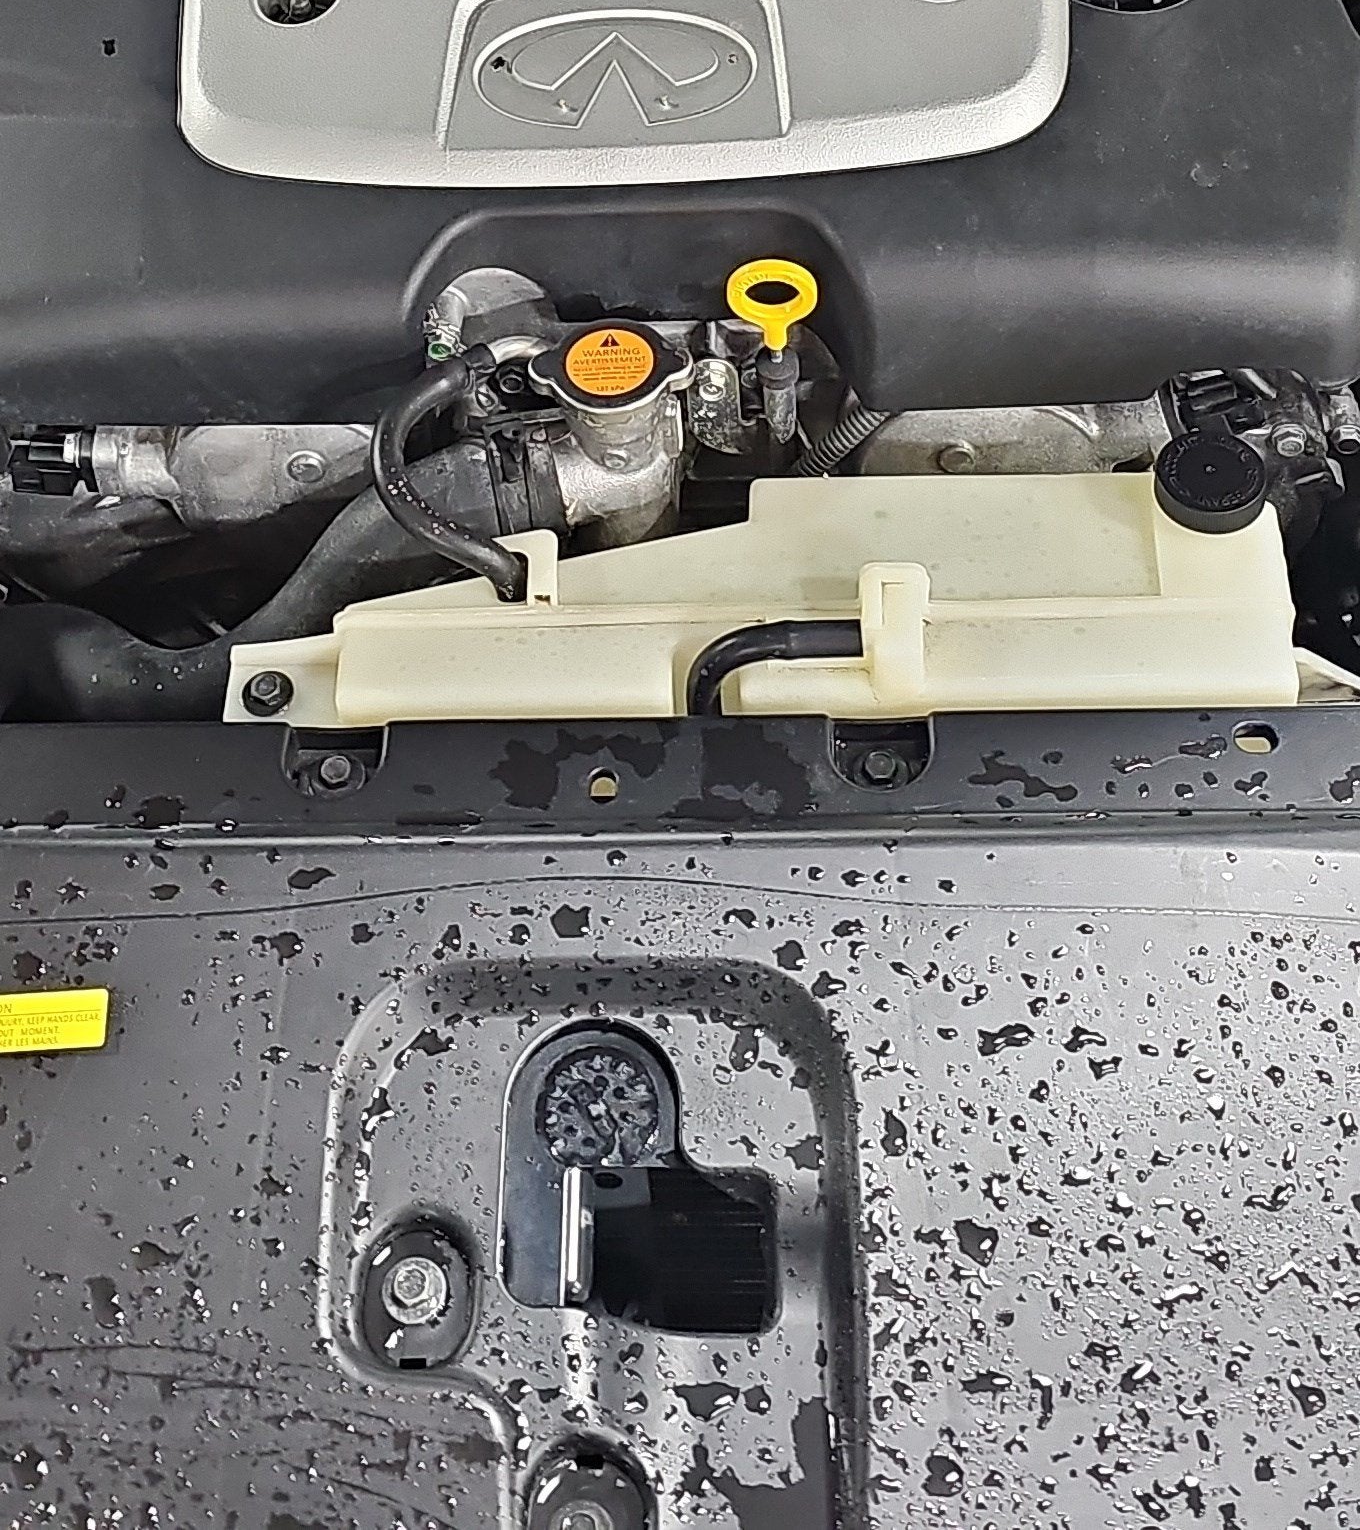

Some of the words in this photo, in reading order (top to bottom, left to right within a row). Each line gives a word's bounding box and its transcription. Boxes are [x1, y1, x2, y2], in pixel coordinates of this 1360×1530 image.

[582, 348, 640, 357] WARNING
[573, 356, 646, 365] AVERTISSEMENT
[27, 1016, 45, 1025] KEEP
[47, 1014, 73, 1023] HANDS
[15, 1037, 29, 1046] LES
